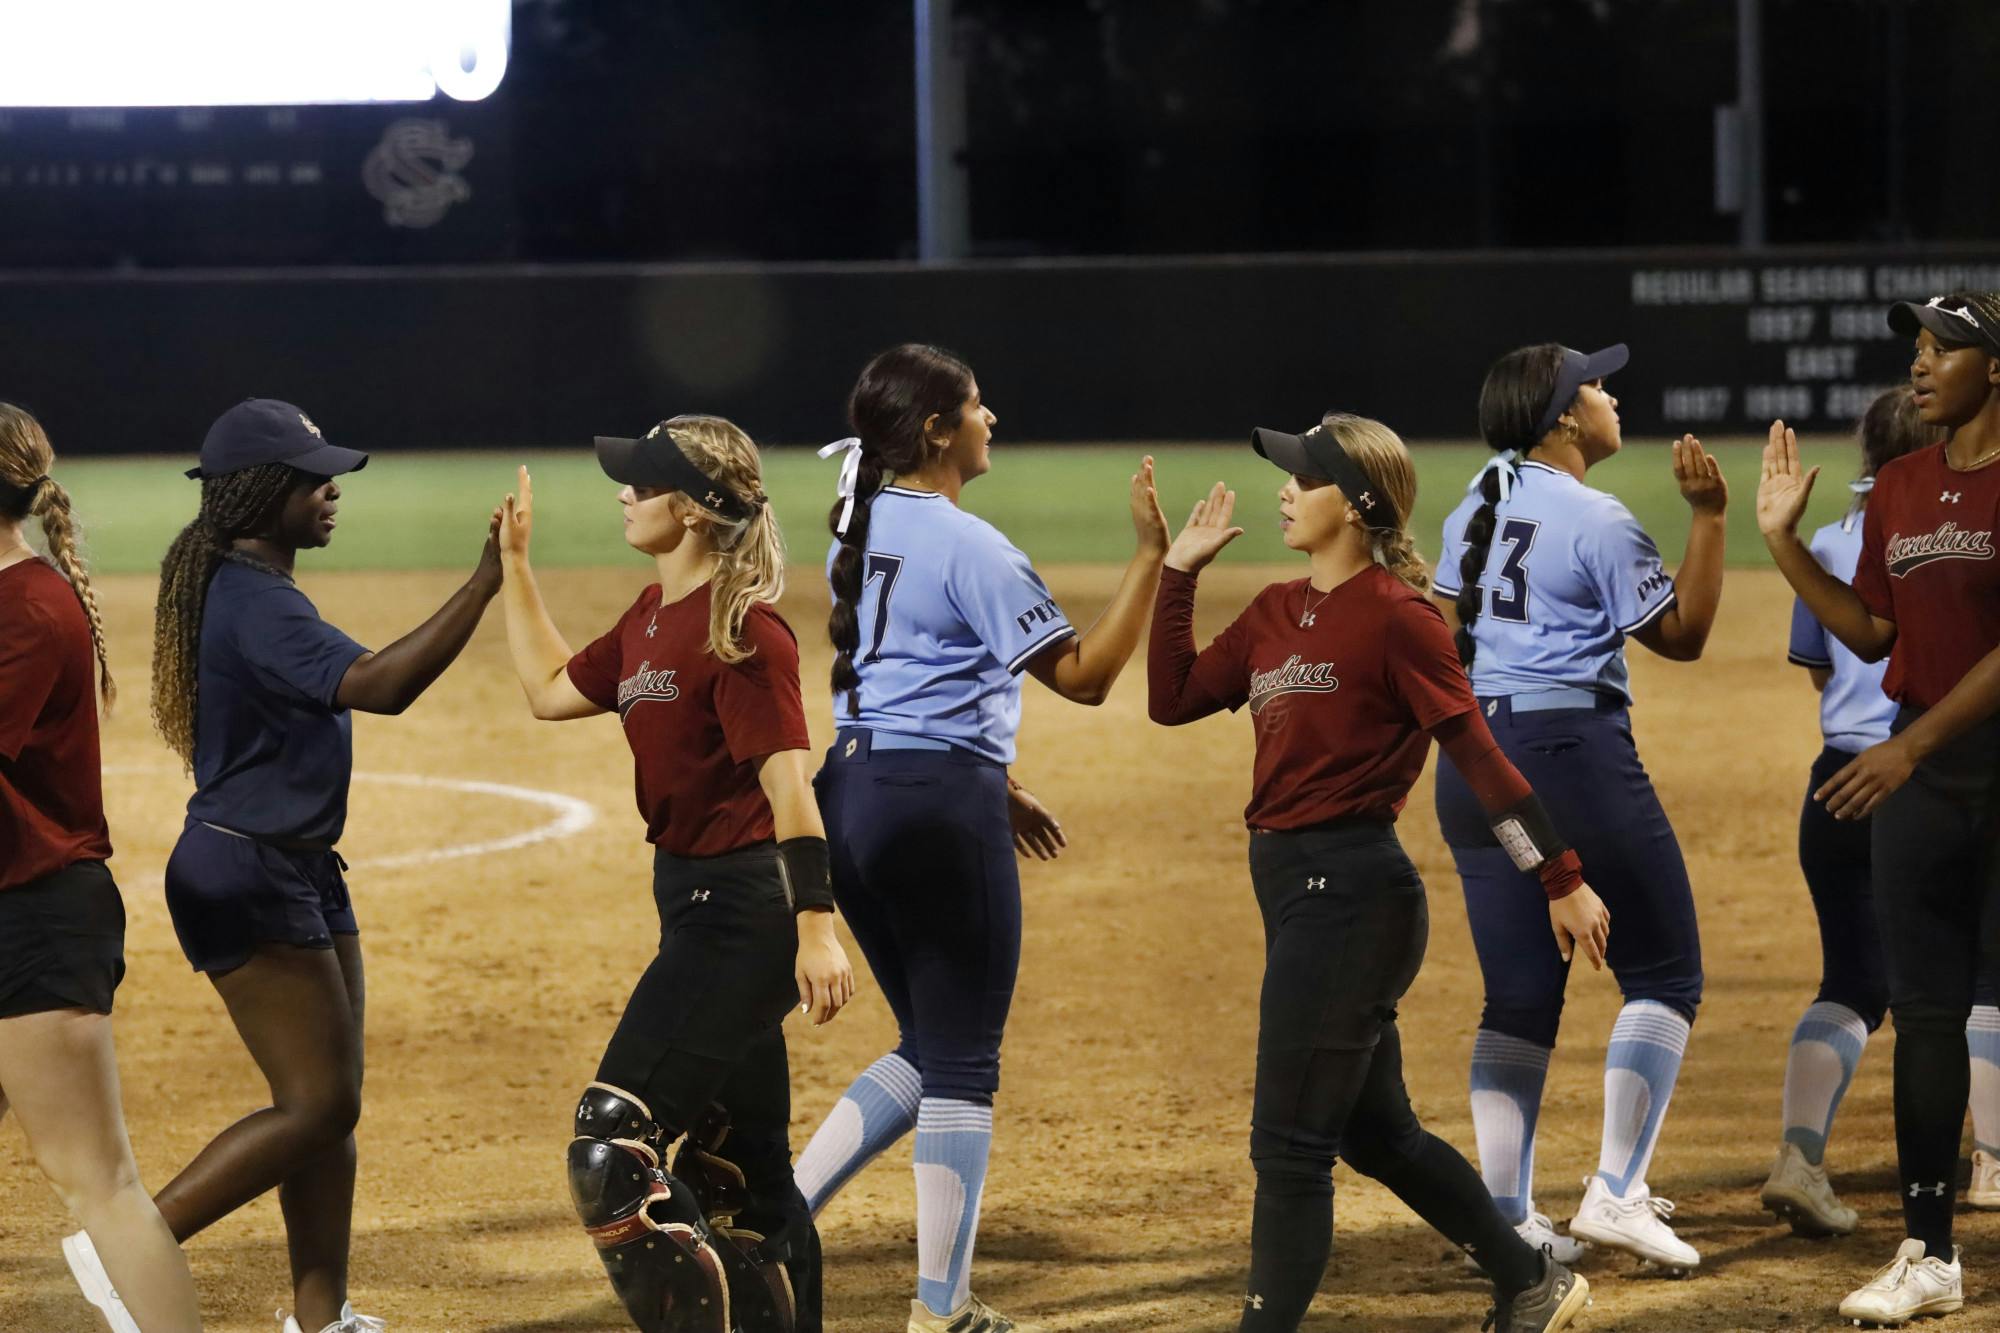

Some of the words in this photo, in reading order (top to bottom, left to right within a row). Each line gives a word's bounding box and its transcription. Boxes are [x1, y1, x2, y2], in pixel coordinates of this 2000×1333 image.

[1631, 269, 1752, 304] REGULAR
[1759, 266, 1867, 302] SEASON
[1786, 346, 1856, 380] EAST
[861, 551, 904, 664] 7
